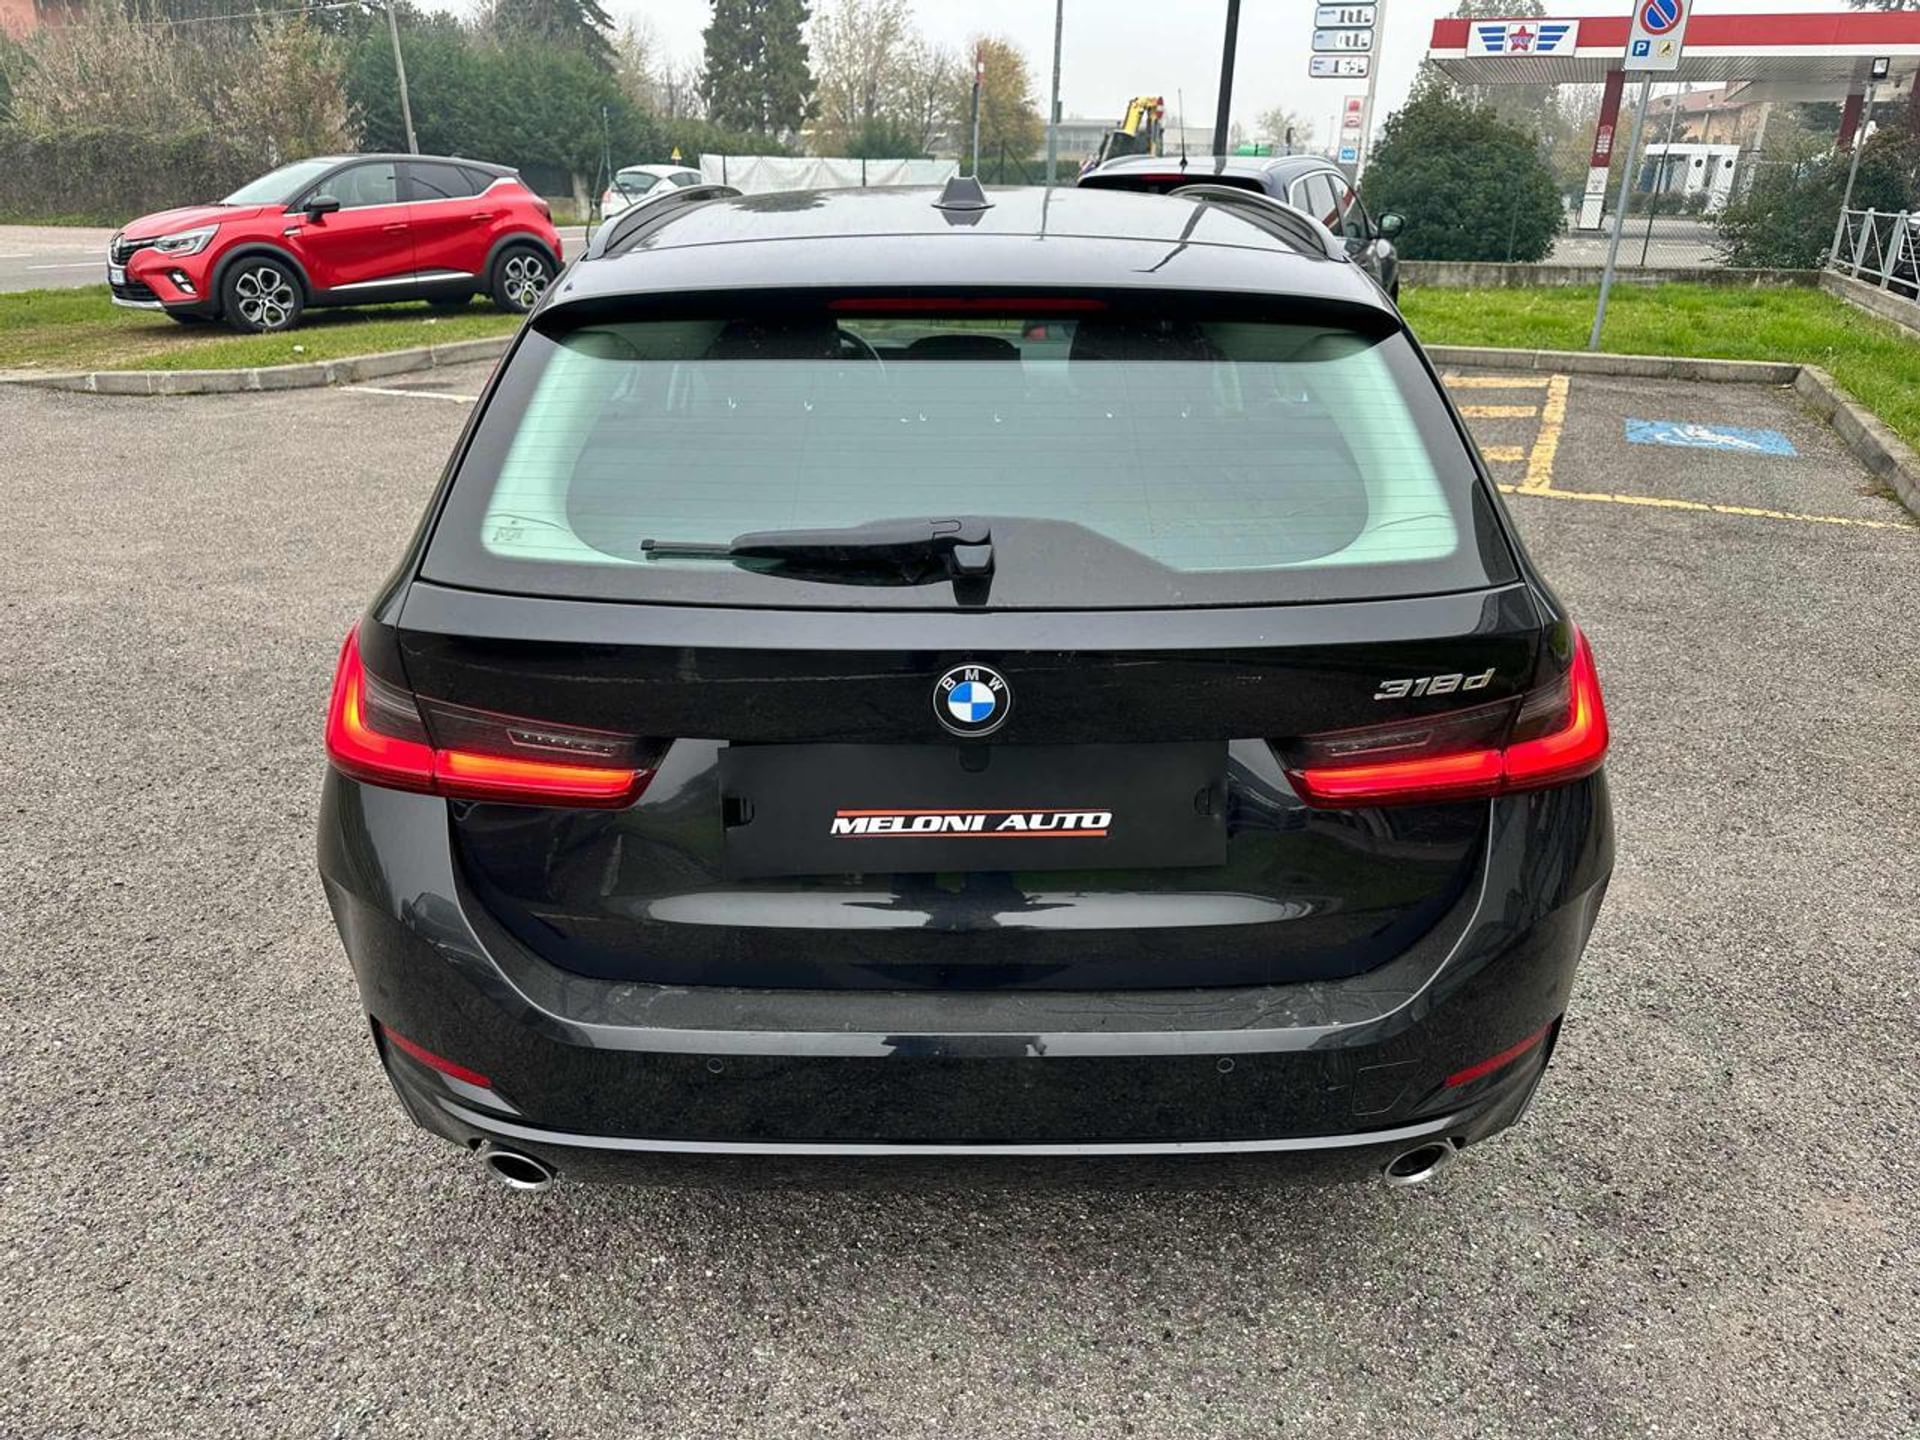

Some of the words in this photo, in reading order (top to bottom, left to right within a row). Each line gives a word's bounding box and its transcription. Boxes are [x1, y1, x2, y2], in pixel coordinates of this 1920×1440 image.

[1635, 42, 1648, 55] P
[941, 668, 1003, 692] BMW
[1373, 667, 1497, 701] 318d
[830, 814, 986, 835] MELONI
[996, 812, 1112, 831] AUTO
